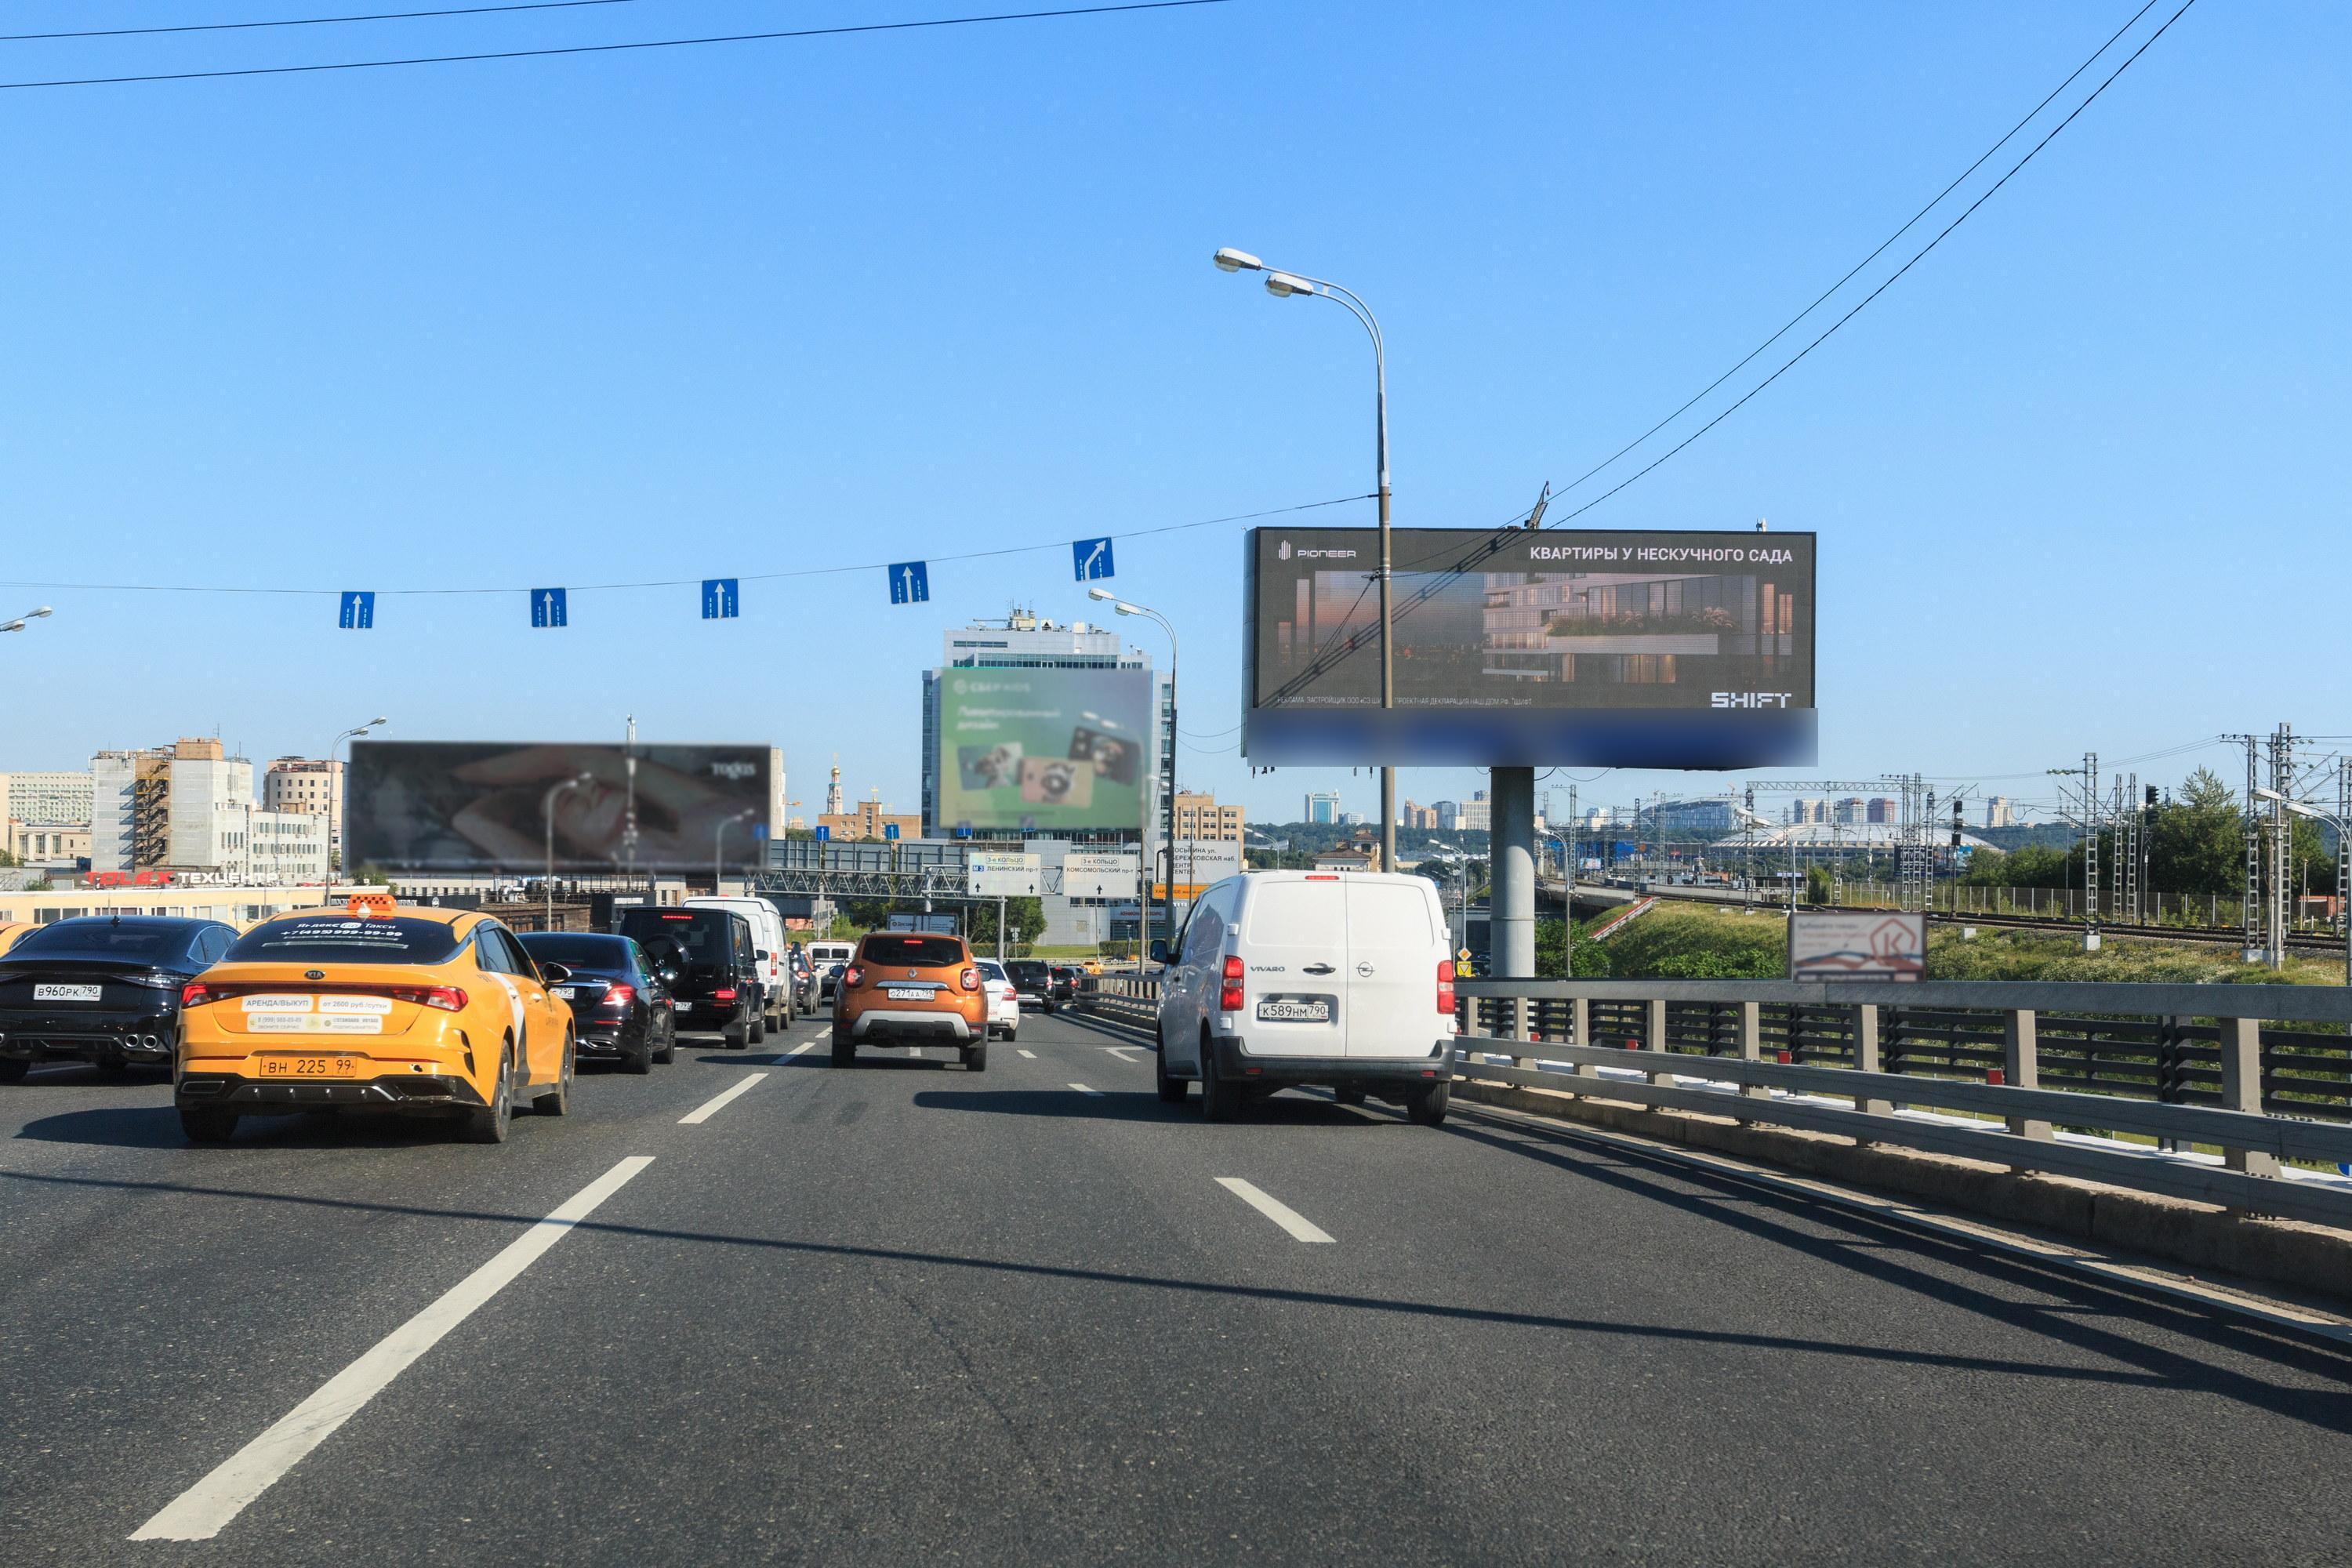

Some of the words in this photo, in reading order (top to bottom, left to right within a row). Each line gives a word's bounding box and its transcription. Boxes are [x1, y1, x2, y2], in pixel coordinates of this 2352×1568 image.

[1298, 549, 1356, 558] PIONEER
[1530, 546, 1617, 560] КВАРТИРЫ
[1622, 548, 1633, 560] У
[1638, 547, 1744, 561] НЕСКУЧНОГО
[1749, 550, 1793, 564] САДА
[1711, 692, 1791, 709] SHIFT
[85, 871, 176, 886] TOLEX
[177, 872, 278, 884] ТЕХЦЕНТР
[38, 986, 79, 997] В960РК
[82, 985, 98, 995] 790
[1263, 1005, 1307, 1017] К589НМ
[1309, 1006, 1326, 1014] 790
[268, 1062, 287, 1073] ВН
[297, 1059, 325, 1073] 225
[336, 1060, 351, 1070] 99
